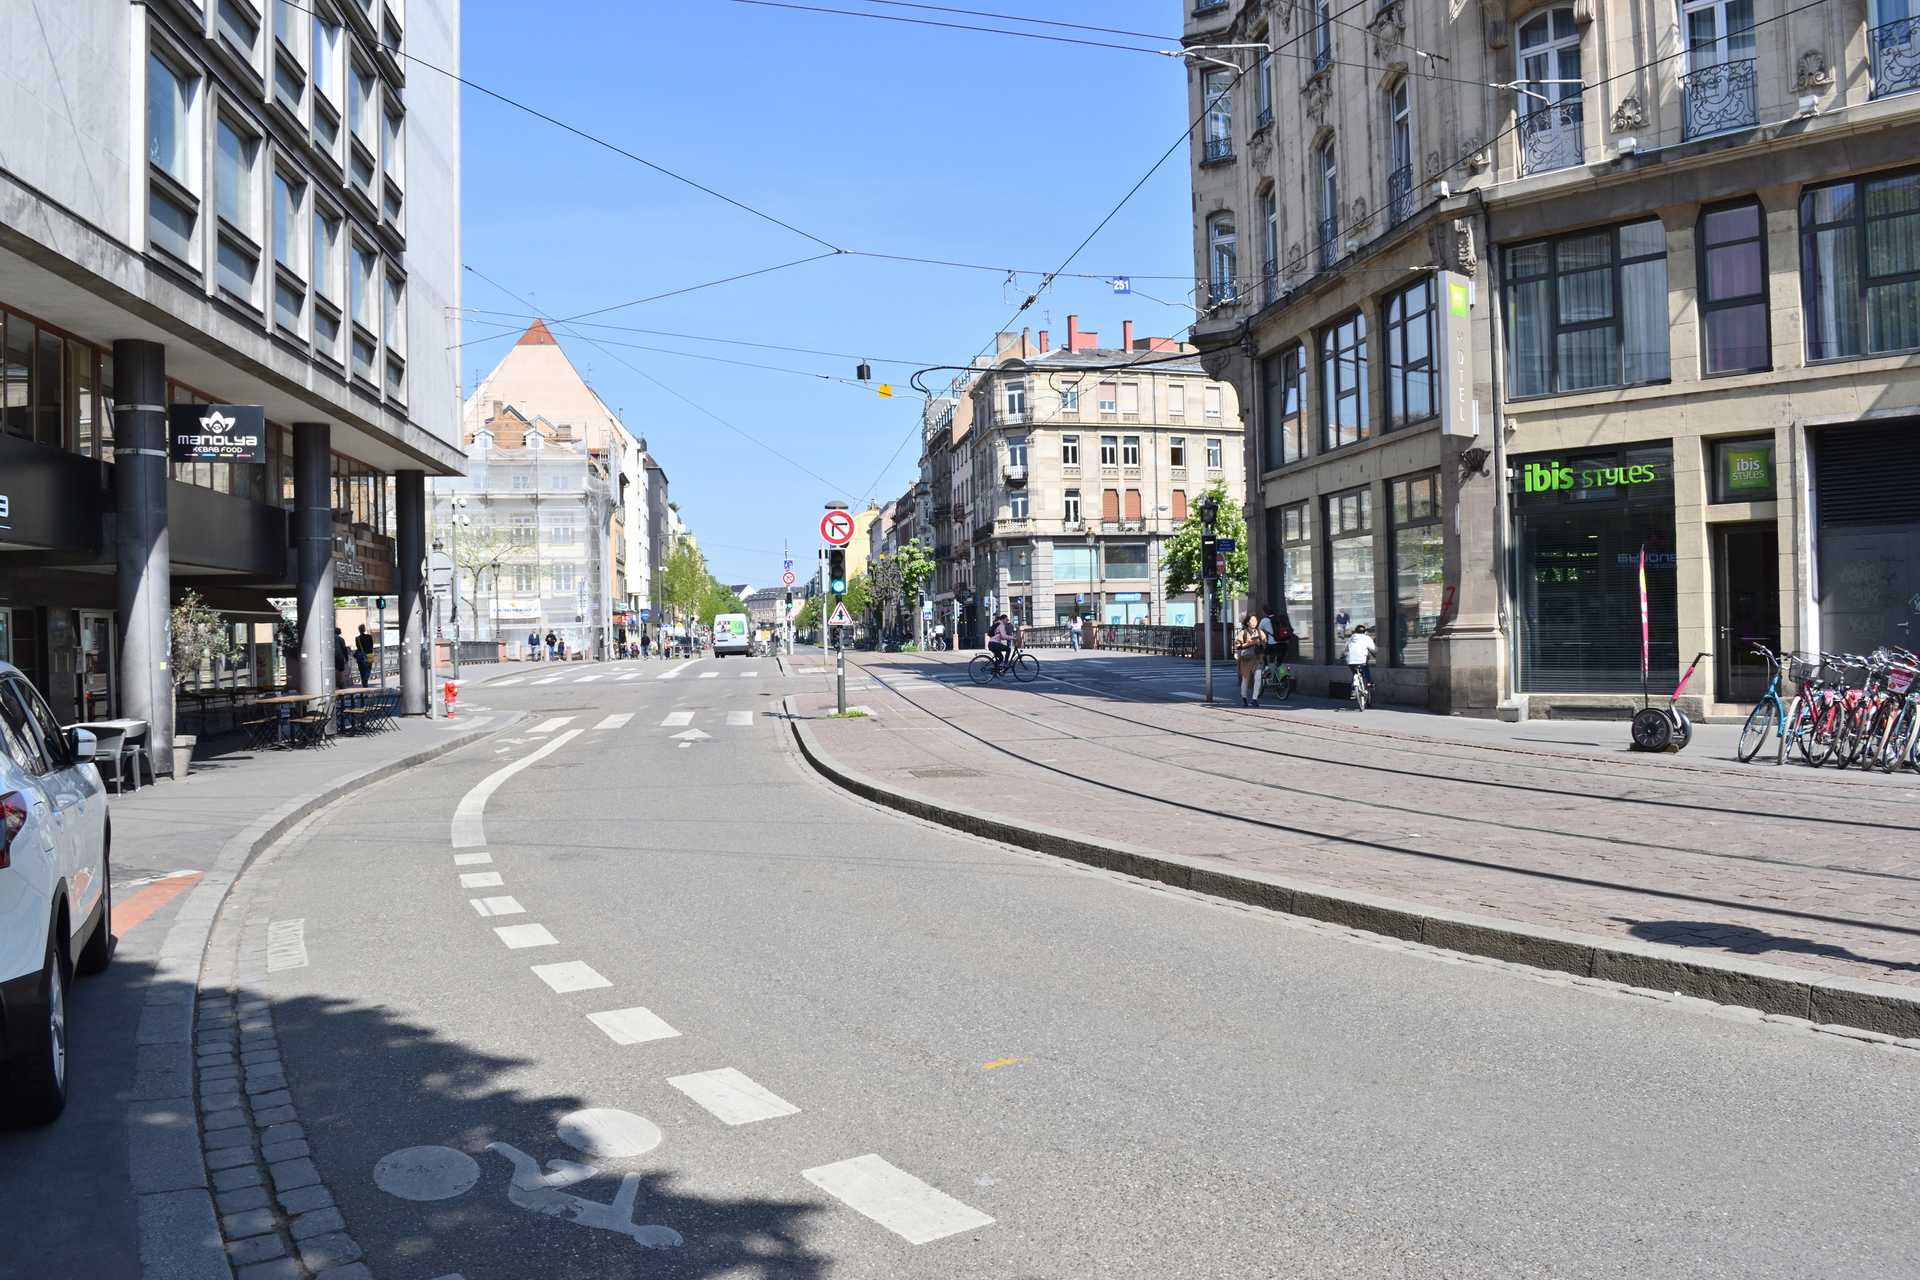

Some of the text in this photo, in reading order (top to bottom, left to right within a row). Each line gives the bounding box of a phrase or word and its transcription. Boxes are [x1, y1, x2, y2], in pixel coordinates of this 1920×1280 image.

[1113, 280, 1129, 290] 251
[1736, 457, 1761, 471] ibis
[1524, 461, 1575, 493] ibis
